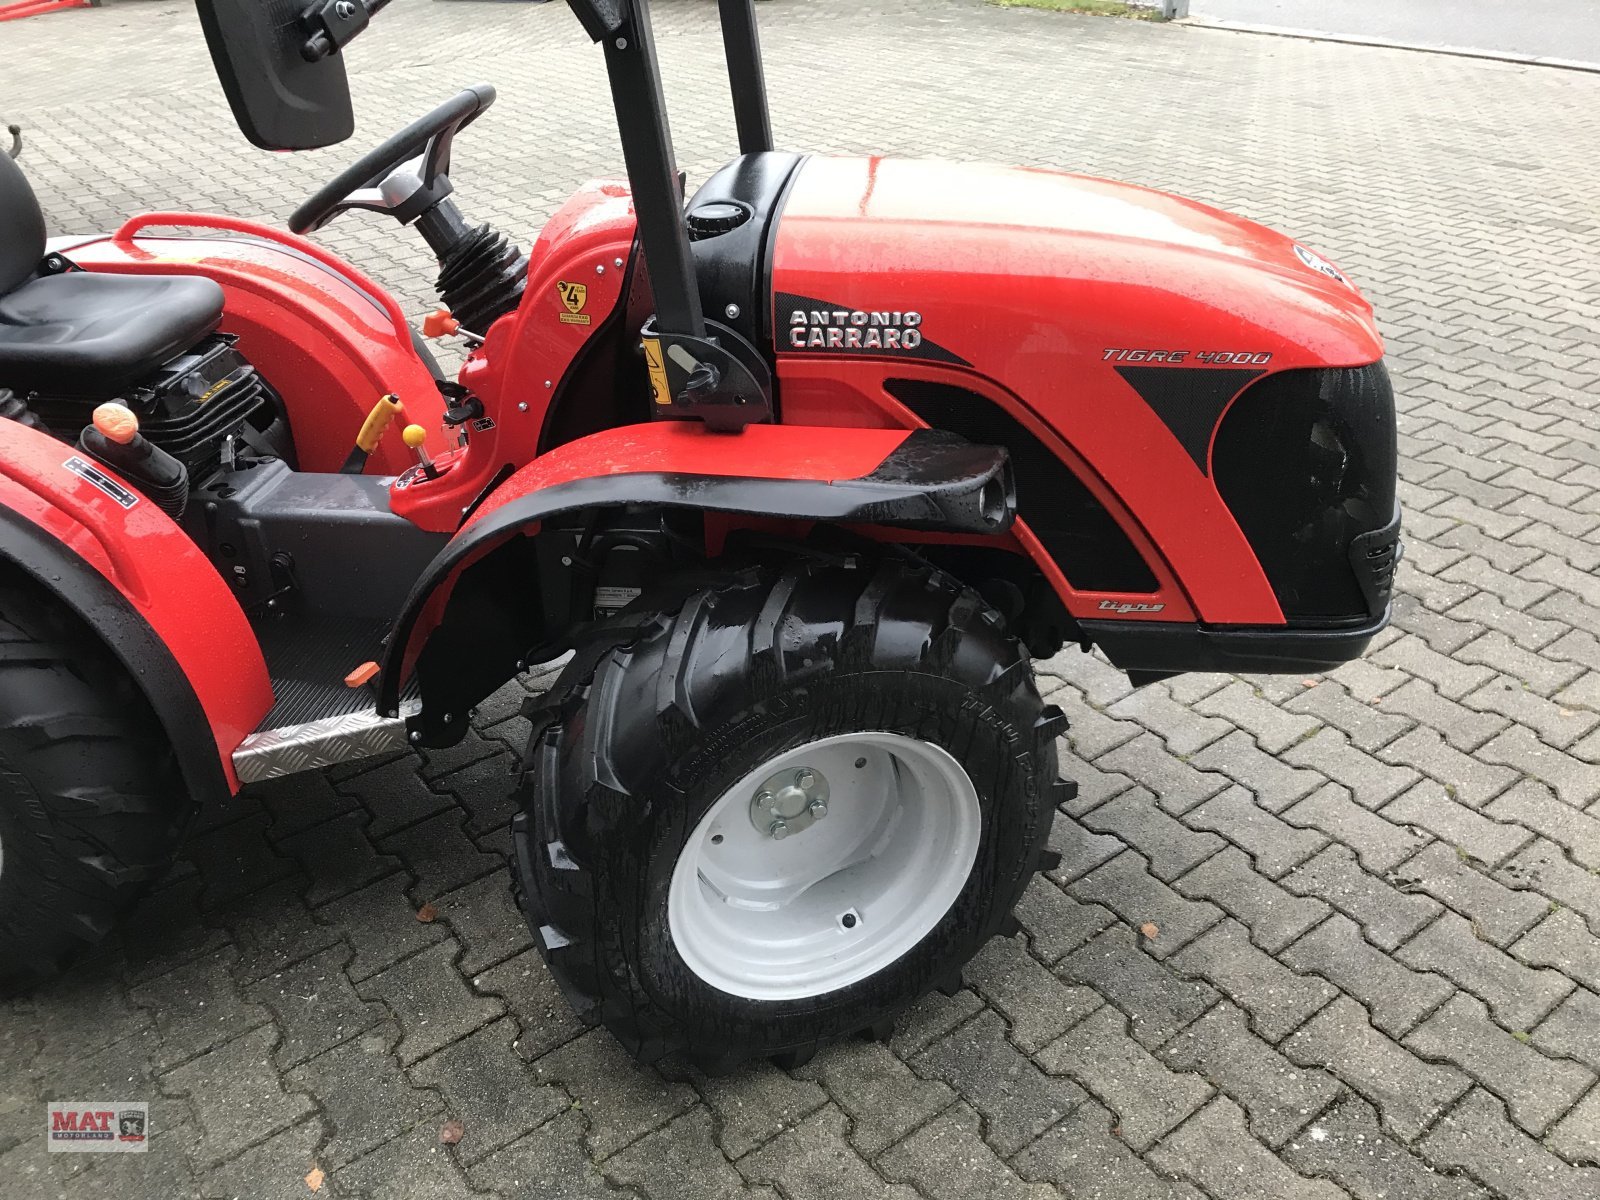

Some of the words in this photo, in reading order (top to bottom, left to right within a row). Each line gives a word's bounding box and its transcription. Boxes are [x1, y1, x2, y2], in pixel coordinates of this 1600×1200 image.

[567, 286, 579, 306] 4
[789, 310, 922, 327] ANTONIO
[789, 327, 922, 350] CARRARO
[1101, 348, 1190, 364] TIGRE
[1196, 350, 1273, 365] 4000
